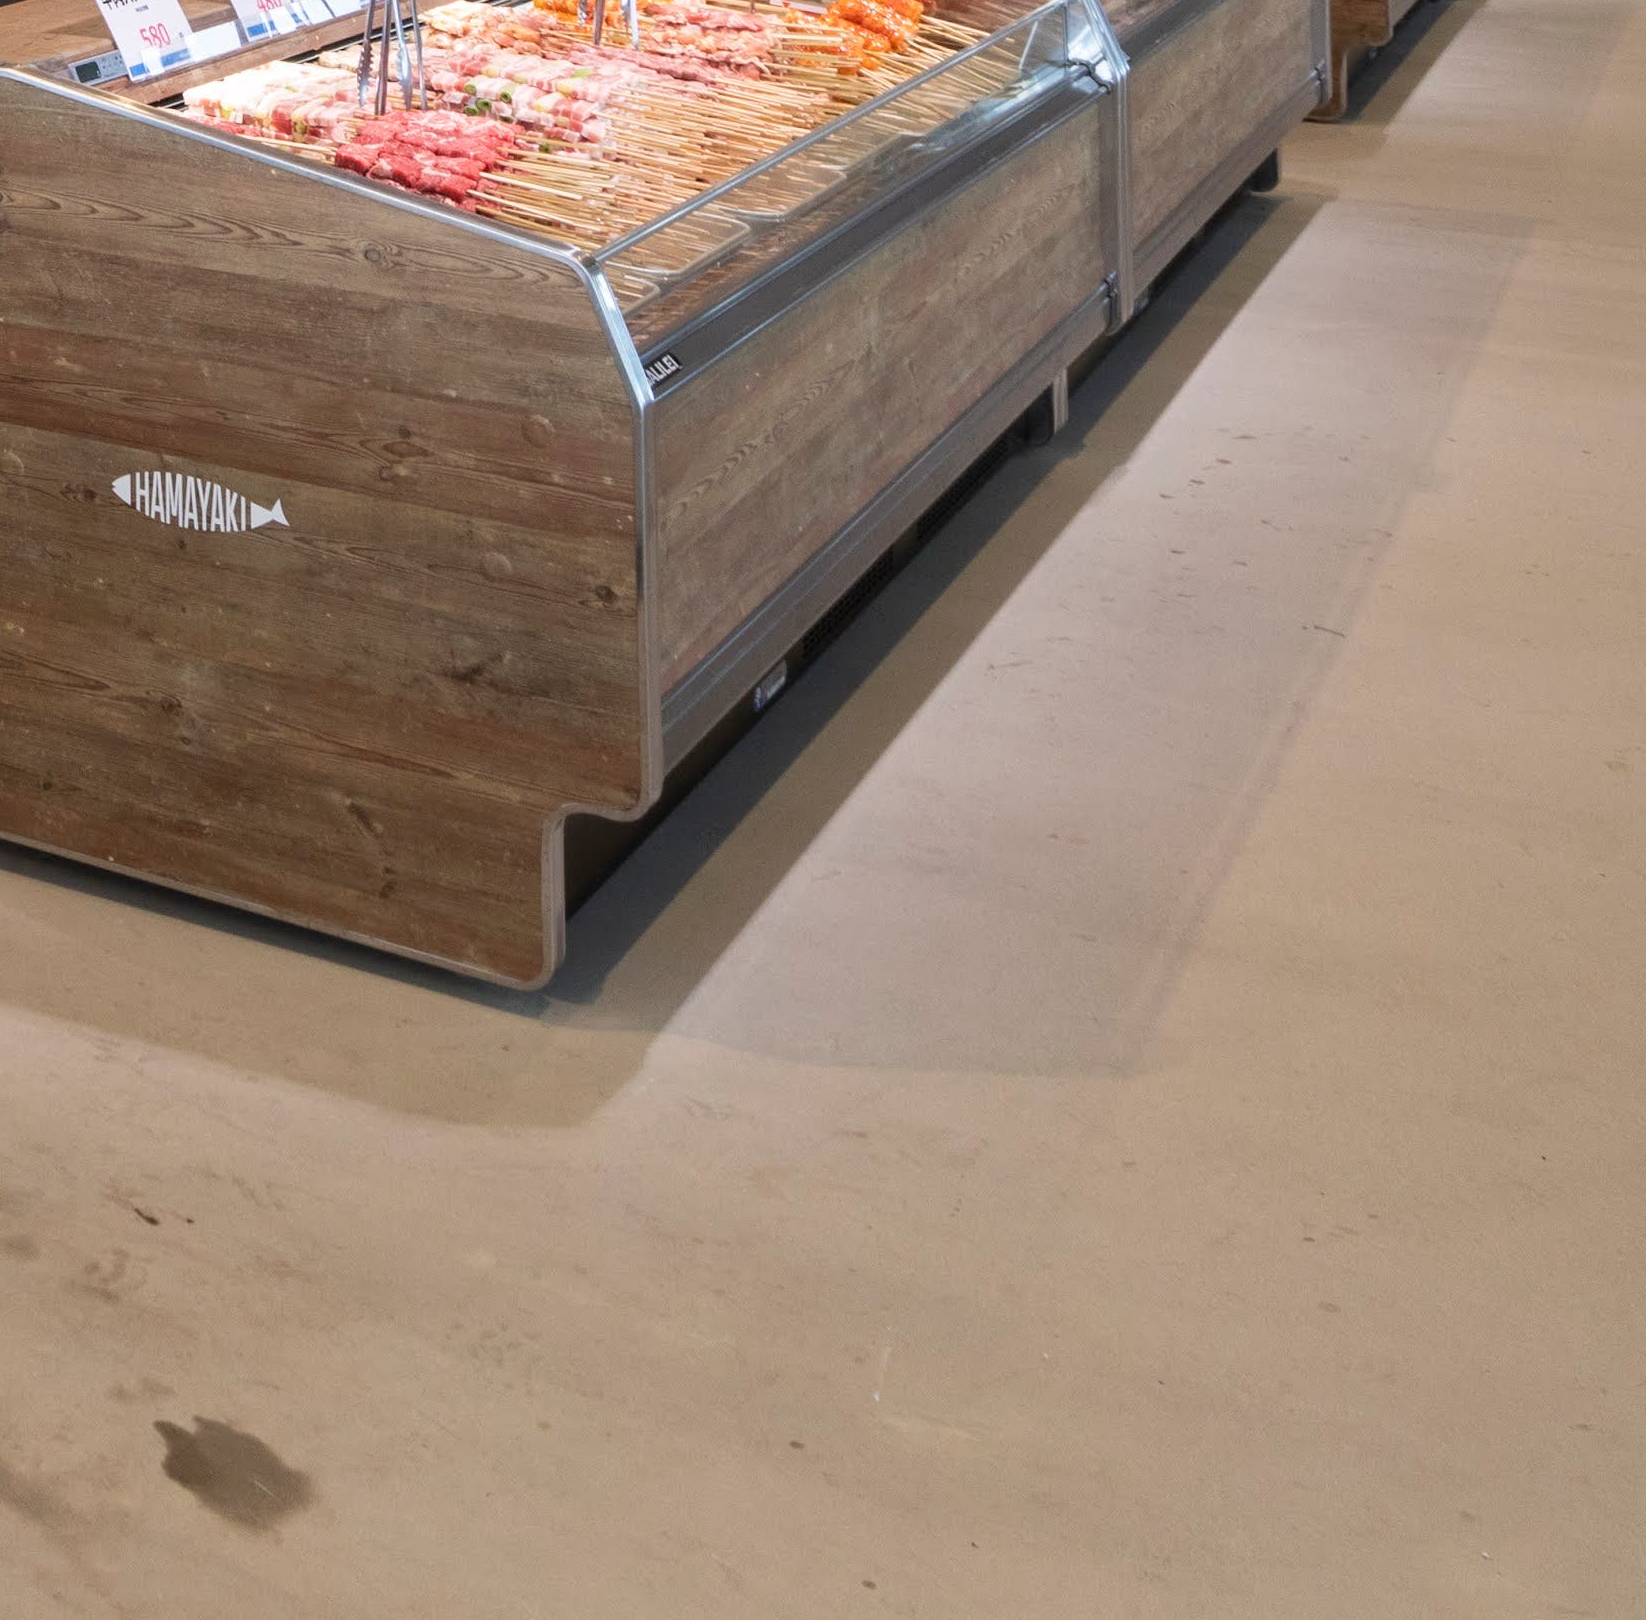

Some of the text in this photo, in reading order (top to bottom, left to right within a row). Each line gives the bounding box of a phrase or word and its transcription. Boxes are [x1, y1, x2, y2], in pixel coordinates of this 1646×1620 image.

[139, 22, 171, 48] 580
[645, 354, 679, 385] ALILEI
[135, 471, 247, 533] HAMAYAKI
